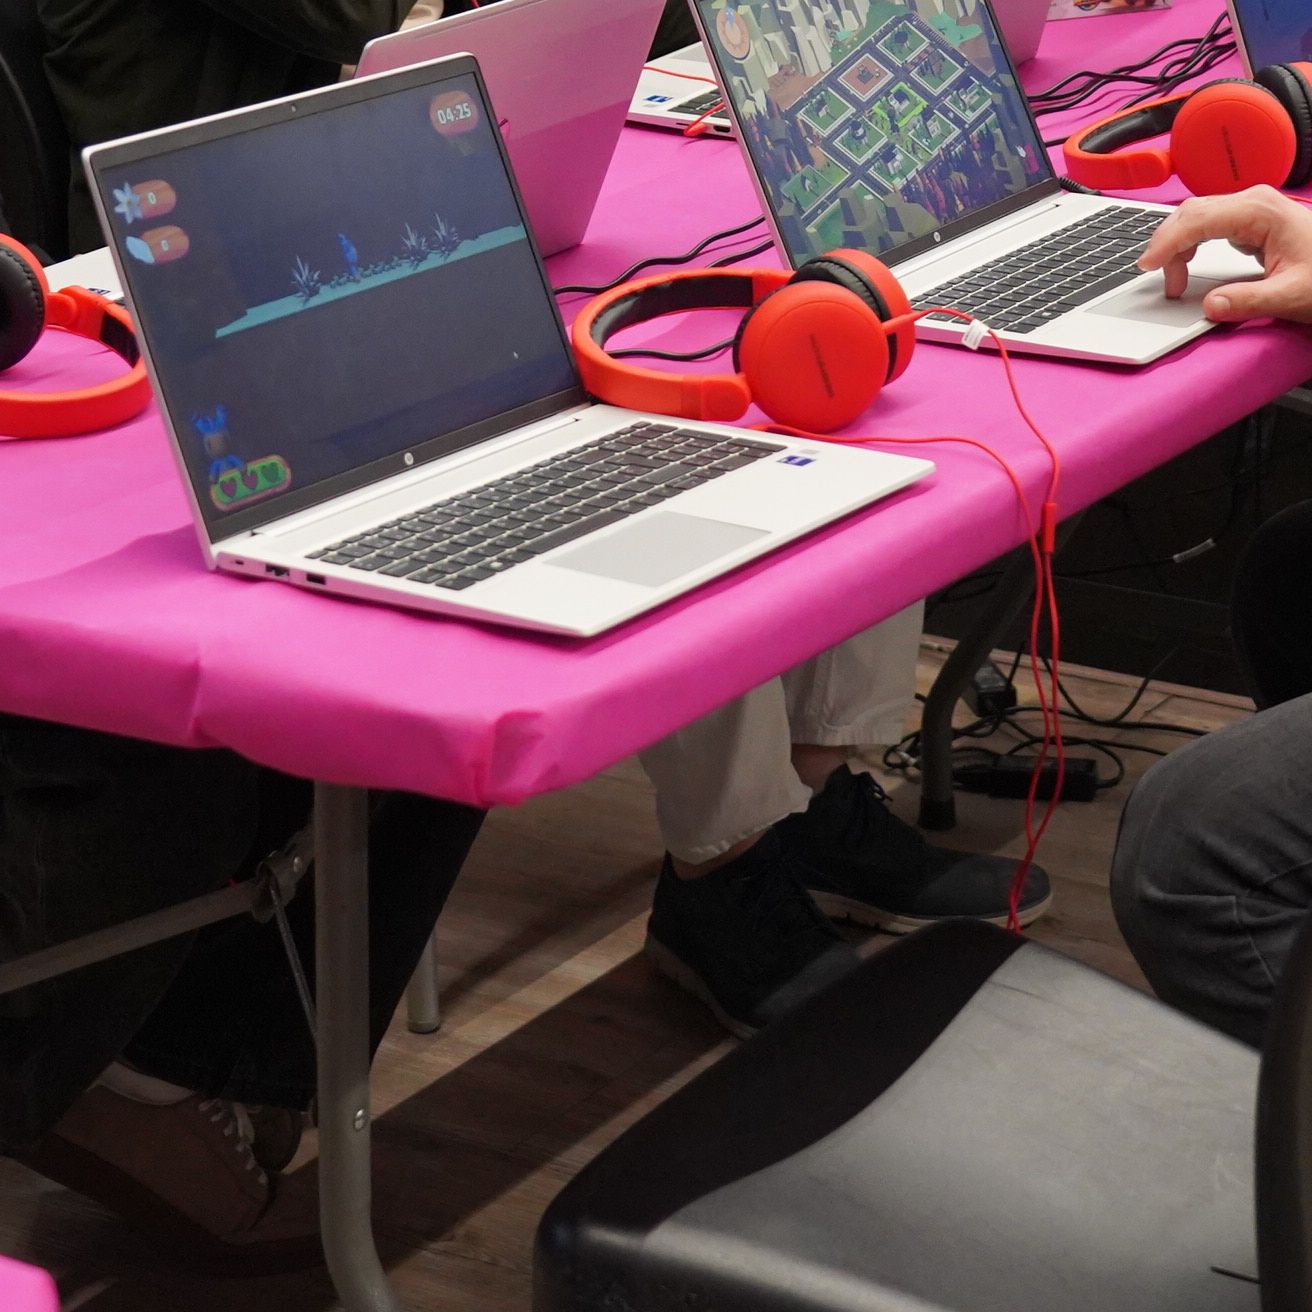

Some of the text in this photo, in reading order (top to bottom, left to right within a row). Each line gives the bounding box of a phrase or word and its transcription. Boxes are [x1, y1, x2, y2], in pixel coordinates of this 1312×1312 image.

[436, 102, 472, 125] 04:25
[147, 191, 157, 205] 0
[160, 239, 170, 253] 0
